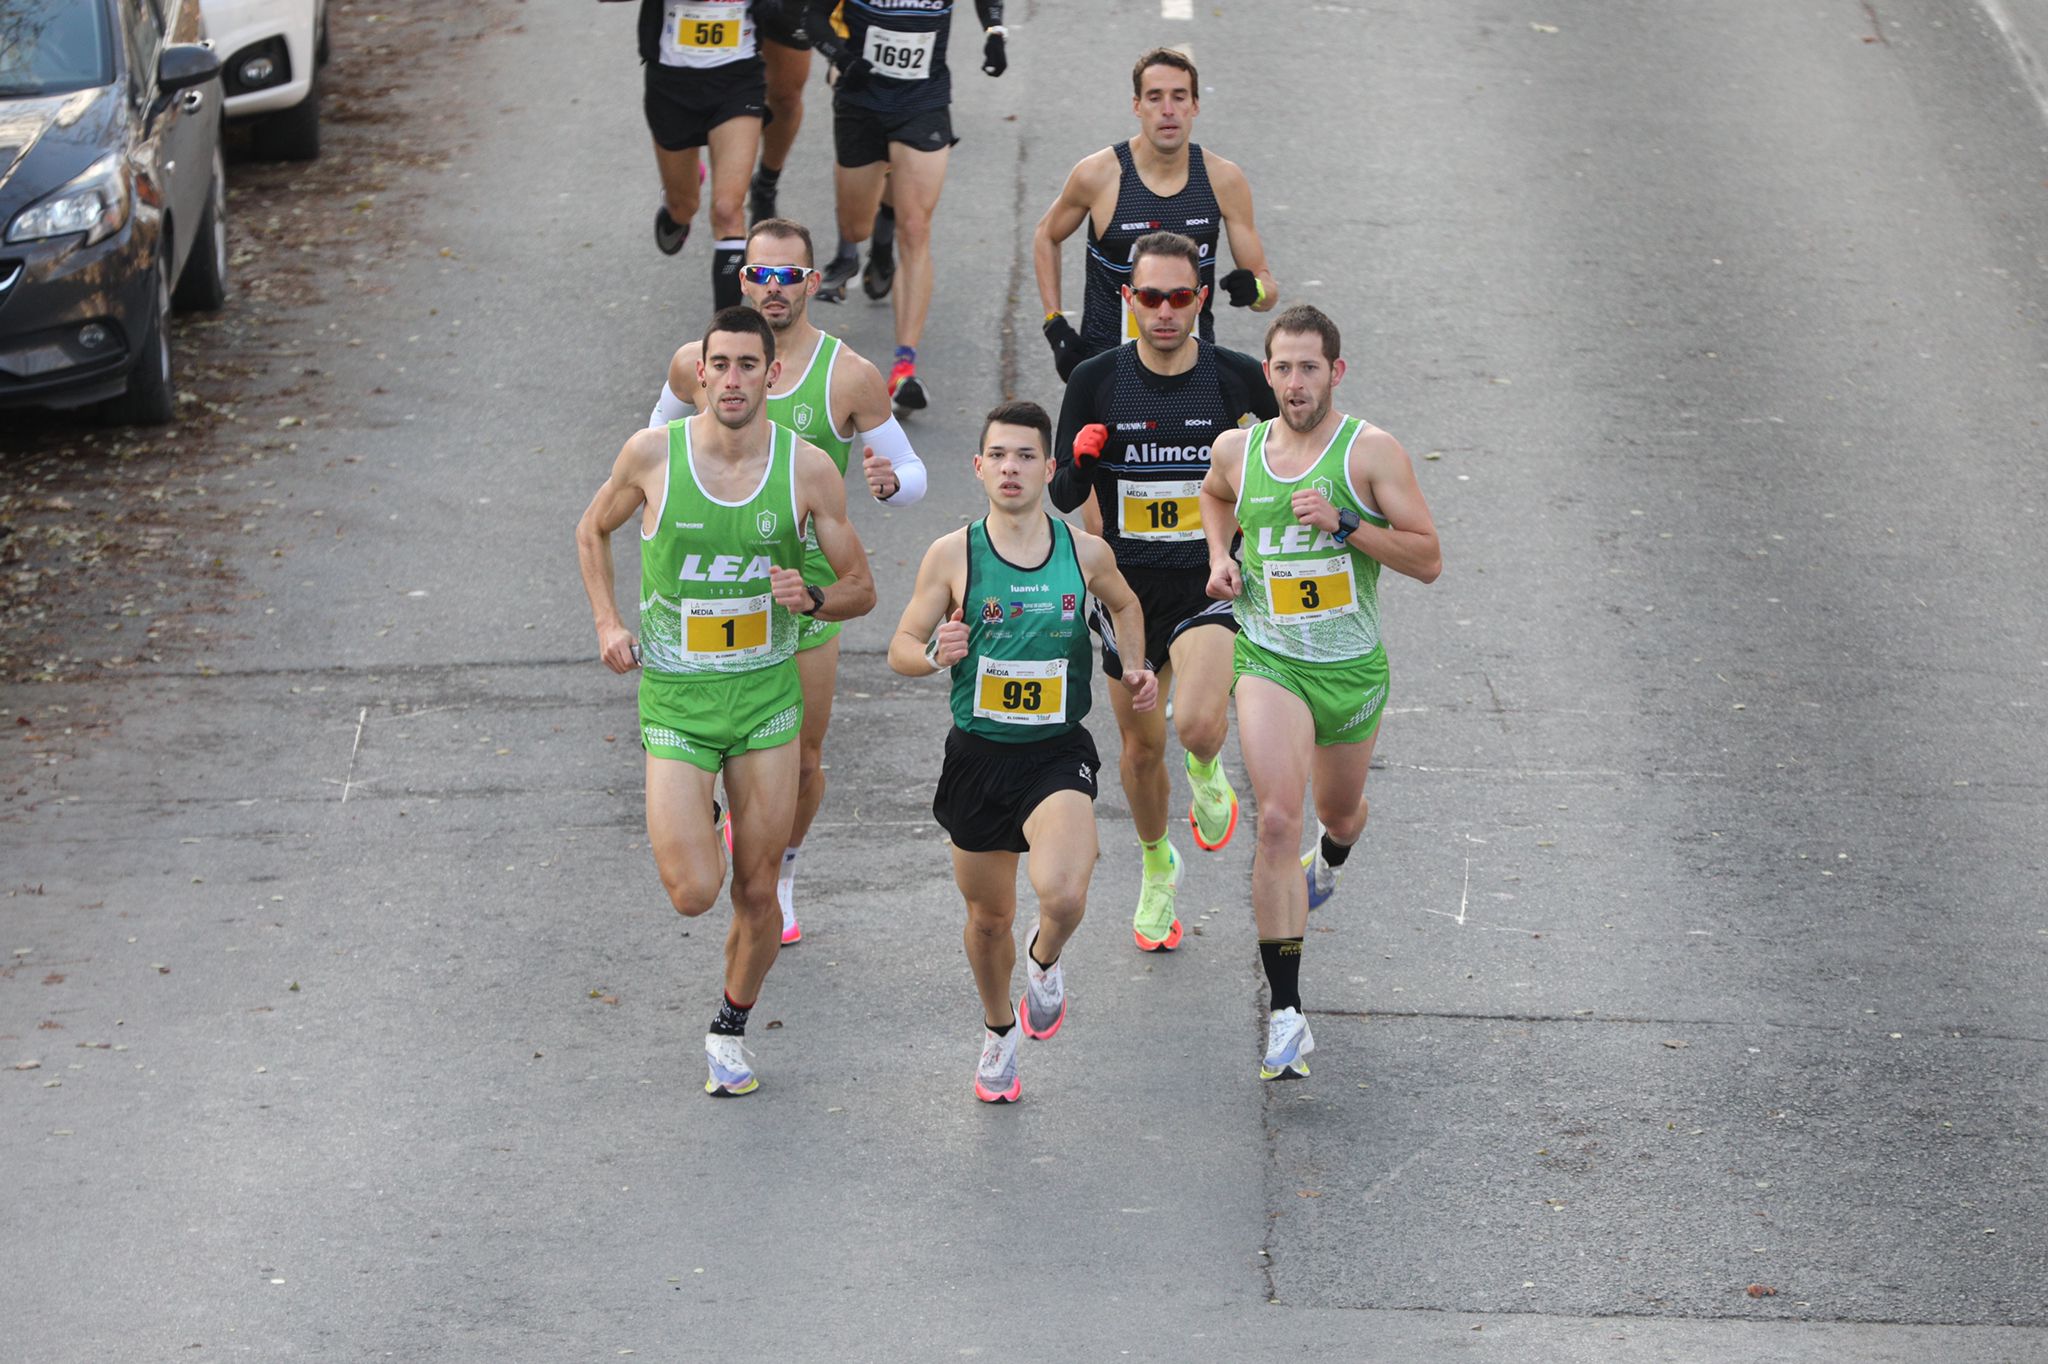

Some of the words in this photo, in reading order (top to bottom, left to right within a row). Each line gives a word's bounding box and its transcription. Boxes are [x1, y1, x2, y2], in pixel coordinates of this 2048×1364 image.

[695, 23, 725, 45] 56
[872, 43, 924, 69] 1692
[1124, 442, 1212, 463] Alimco
[1146, 500, 1179, 529] 18
[1257, 524, 1347, 556] LEA
[679, 554, 772, 583] LEA
[1271, 570, 1293, 578] MEDIA
[1010, 584, 1039, 593] luanvi
[1300, 580, 1320, 609] 3
[721, 619, 735, 647] 1
[986, 668, 1009, 676] MEDIA
[1002, 681, 1042, 711] 93
